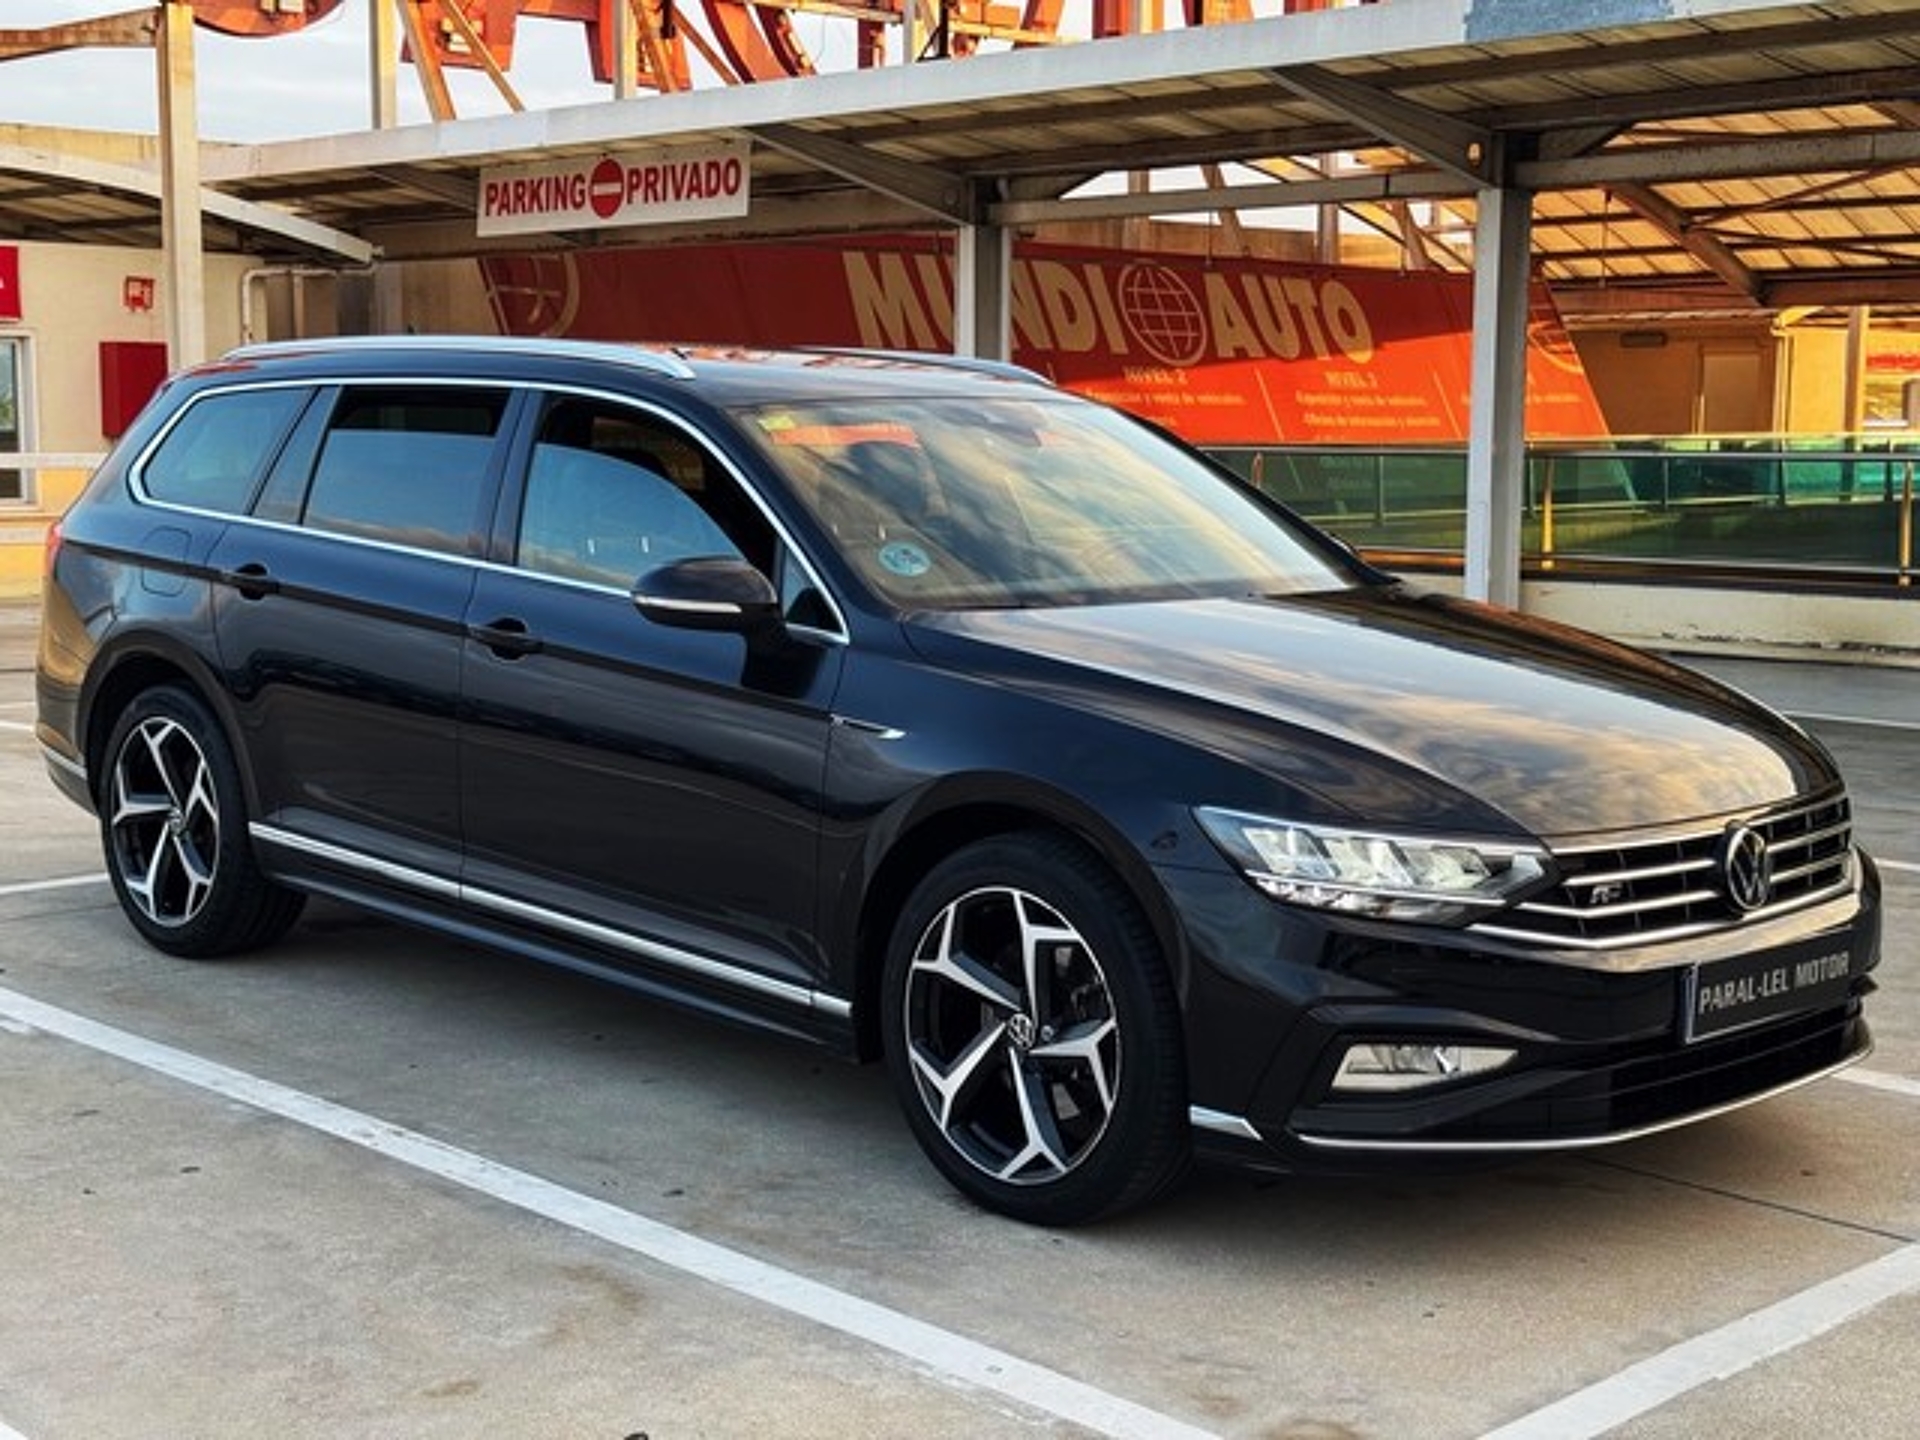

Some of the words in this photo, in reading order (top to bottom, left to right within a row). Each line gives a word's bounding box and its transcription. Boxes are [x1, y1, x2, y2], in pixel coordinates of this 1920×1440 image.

[486, 174, 585, 216] PARKING
[627, 158, 741, 204] PRIVADO
[1204, 272, 1372, 364] AUTO
[1795, 951, 1849, 988] MOTOR
